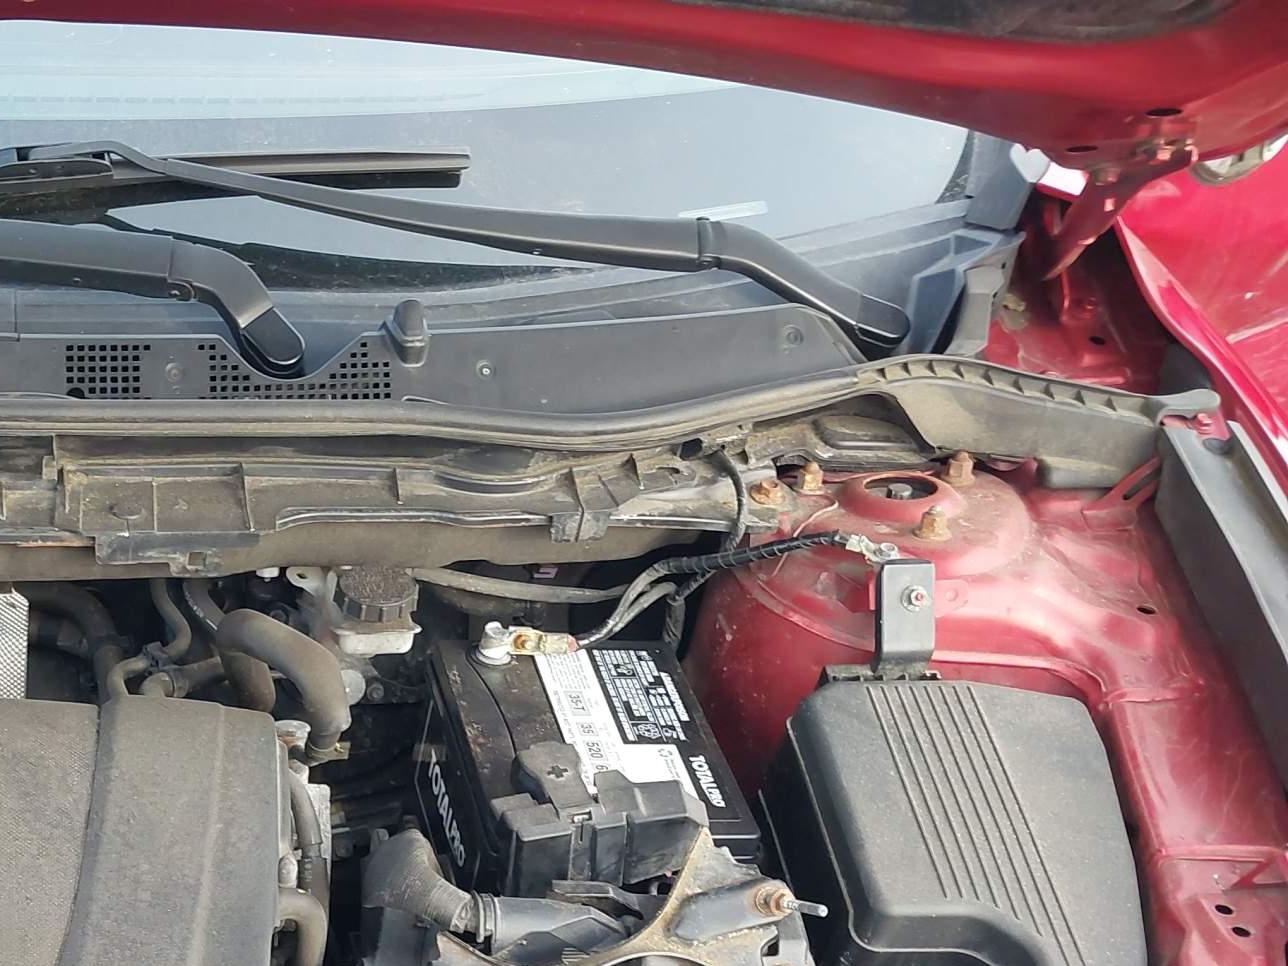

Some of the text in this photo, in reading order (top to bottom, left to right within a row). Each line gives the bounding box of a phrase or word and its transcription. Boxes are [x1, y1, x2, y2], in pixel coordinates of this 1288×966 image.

[586, 742, 604, 759] 520
[428, 748, 466, 868] TOTALPRO
[689, 755, 727, 808] TOTALPRO
